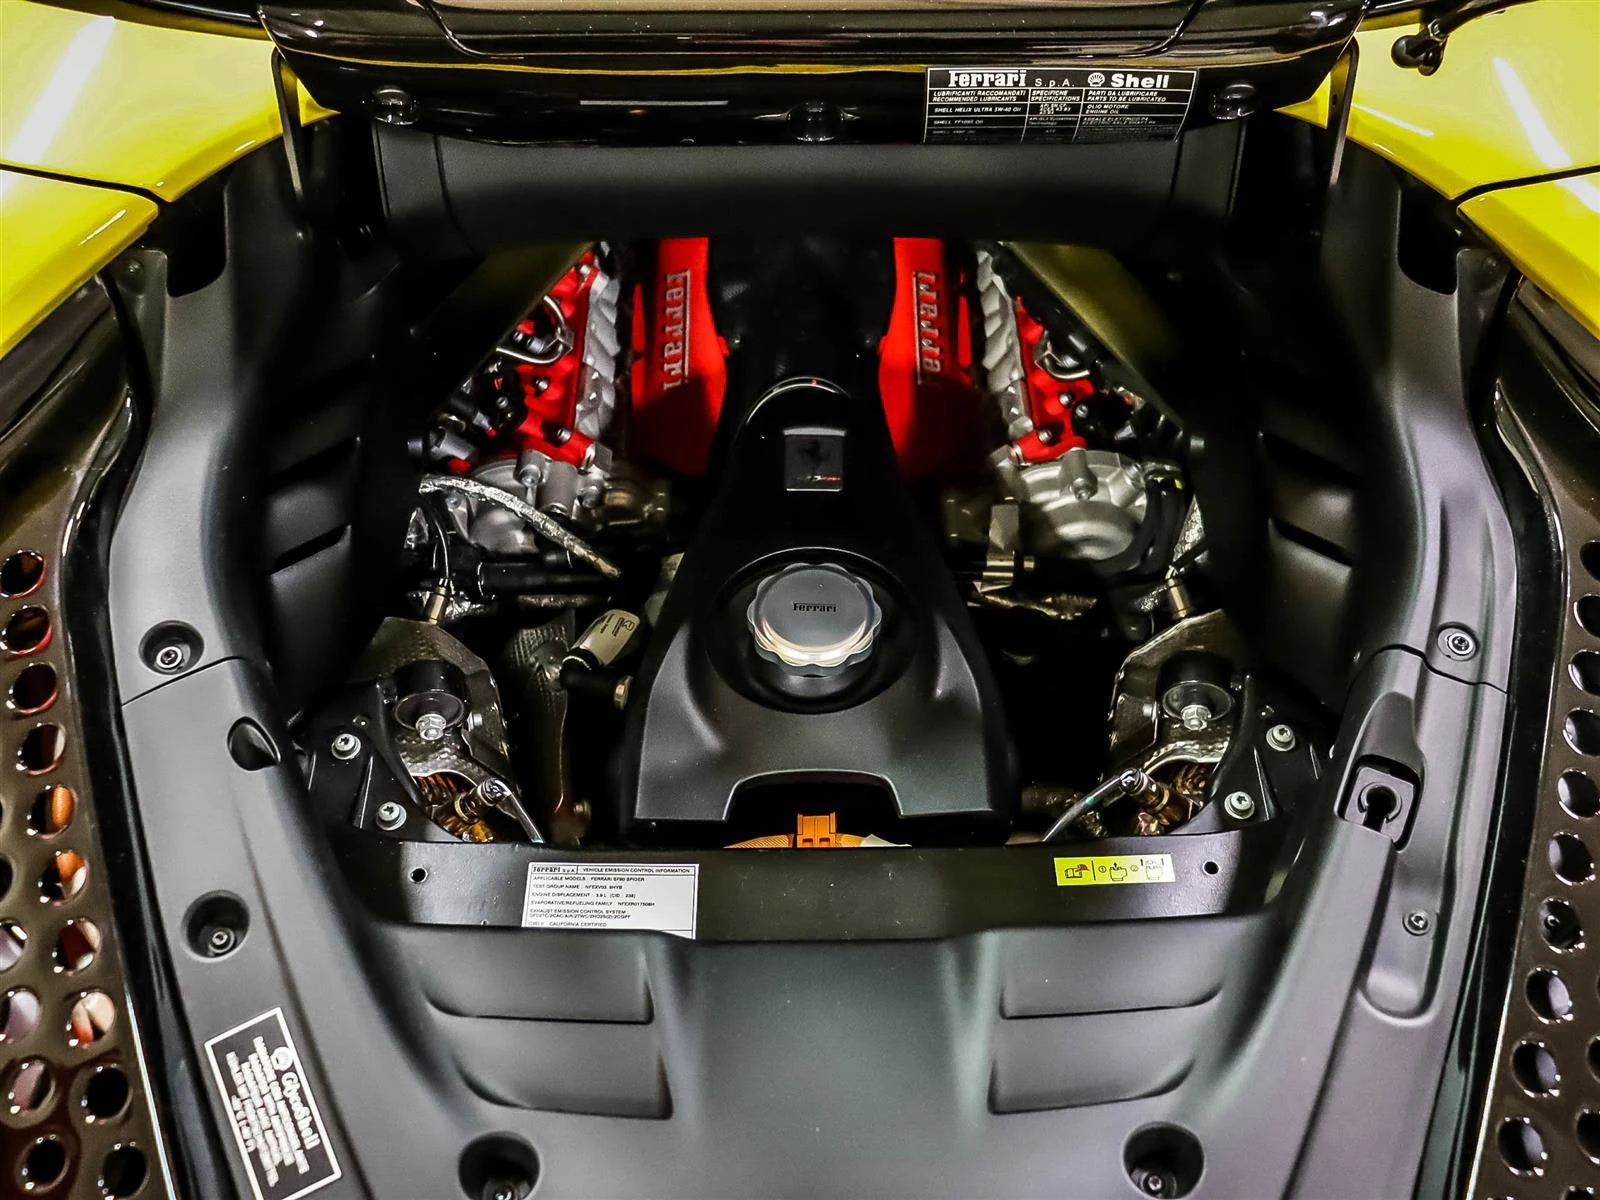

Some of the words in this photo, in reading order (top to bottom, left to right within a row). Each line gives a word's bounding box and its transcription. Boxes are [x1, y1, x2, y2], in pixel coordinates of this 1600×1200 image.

[948, 70, 1026, 87] Ferrari
[1035, 78, 1075, 88] S.p.A.
[1111, 74, 1169, 88] Shell
[663, 269, 691, 391] Ferrari
[912, 271, 941, 385] errari
[792, 602, 838, 613] Ferrari
